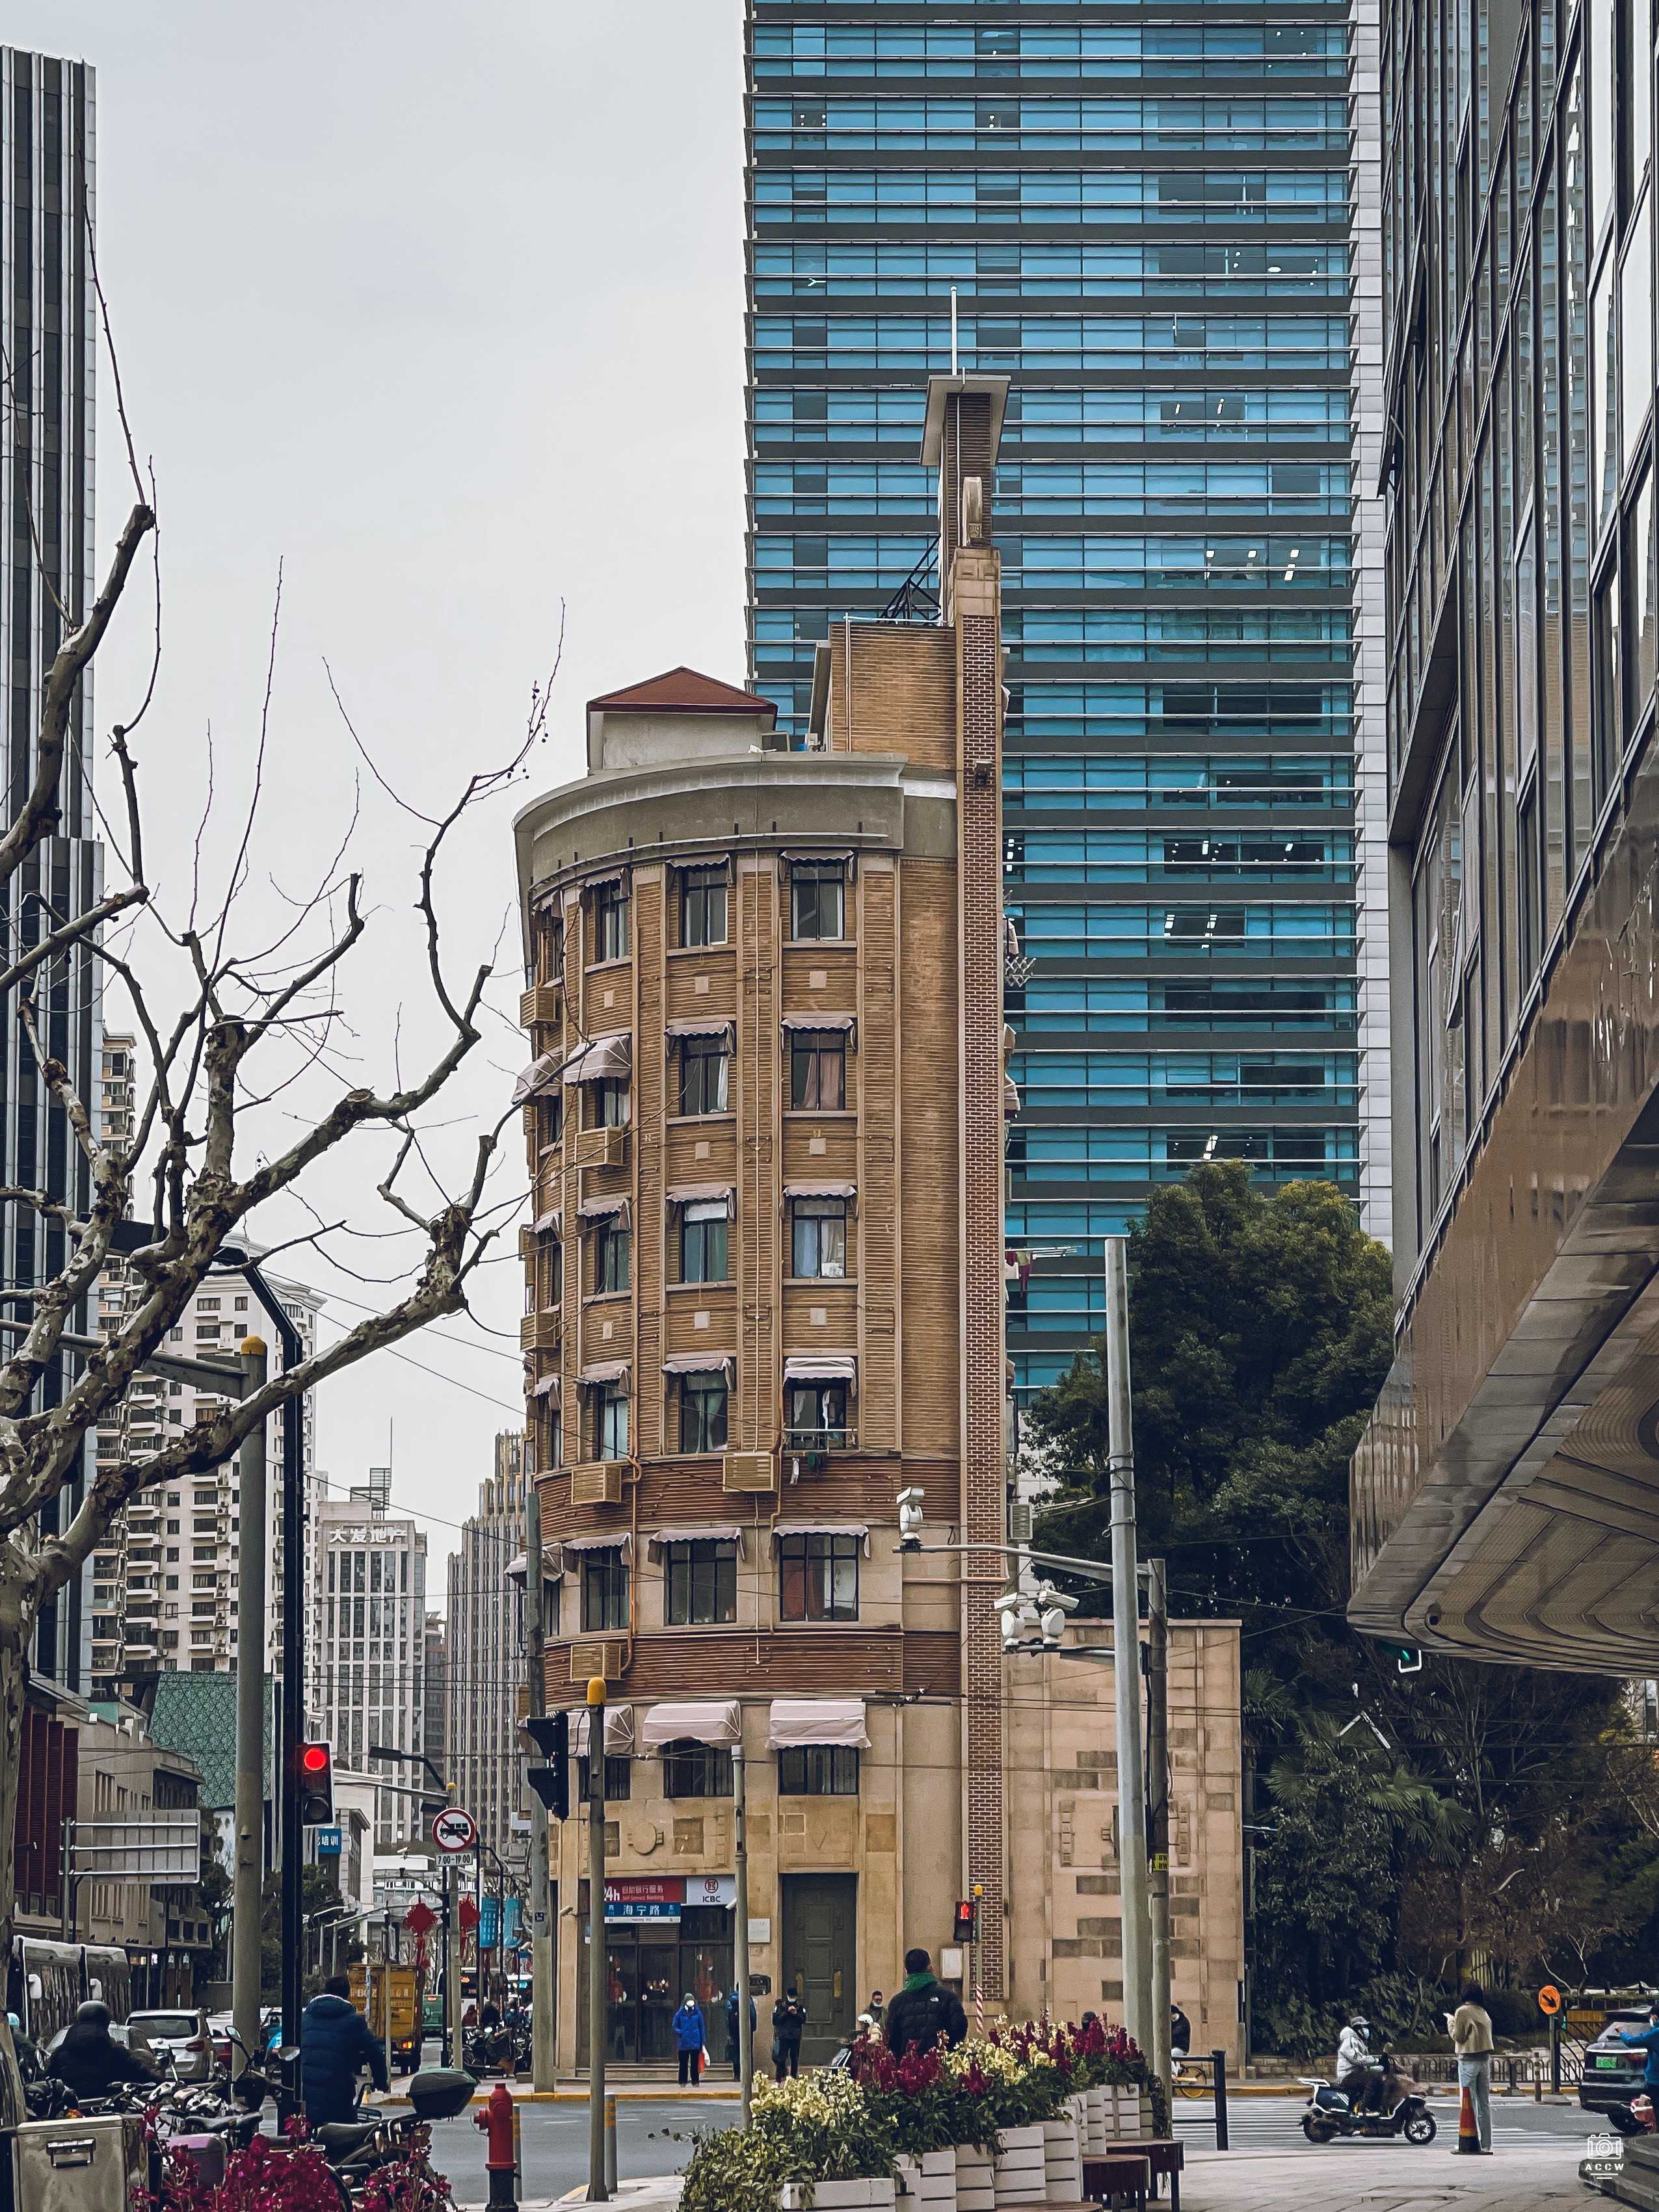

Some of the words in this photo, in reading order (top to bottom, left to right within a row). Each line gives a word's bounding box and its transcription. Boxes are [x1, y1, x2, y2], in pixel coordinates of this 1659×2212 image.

[329, 1527, 408, 1543] 大发地产
[318, 1835, 338, 1846] 培训
[623, 1904, 660, 1916] 海宁路
